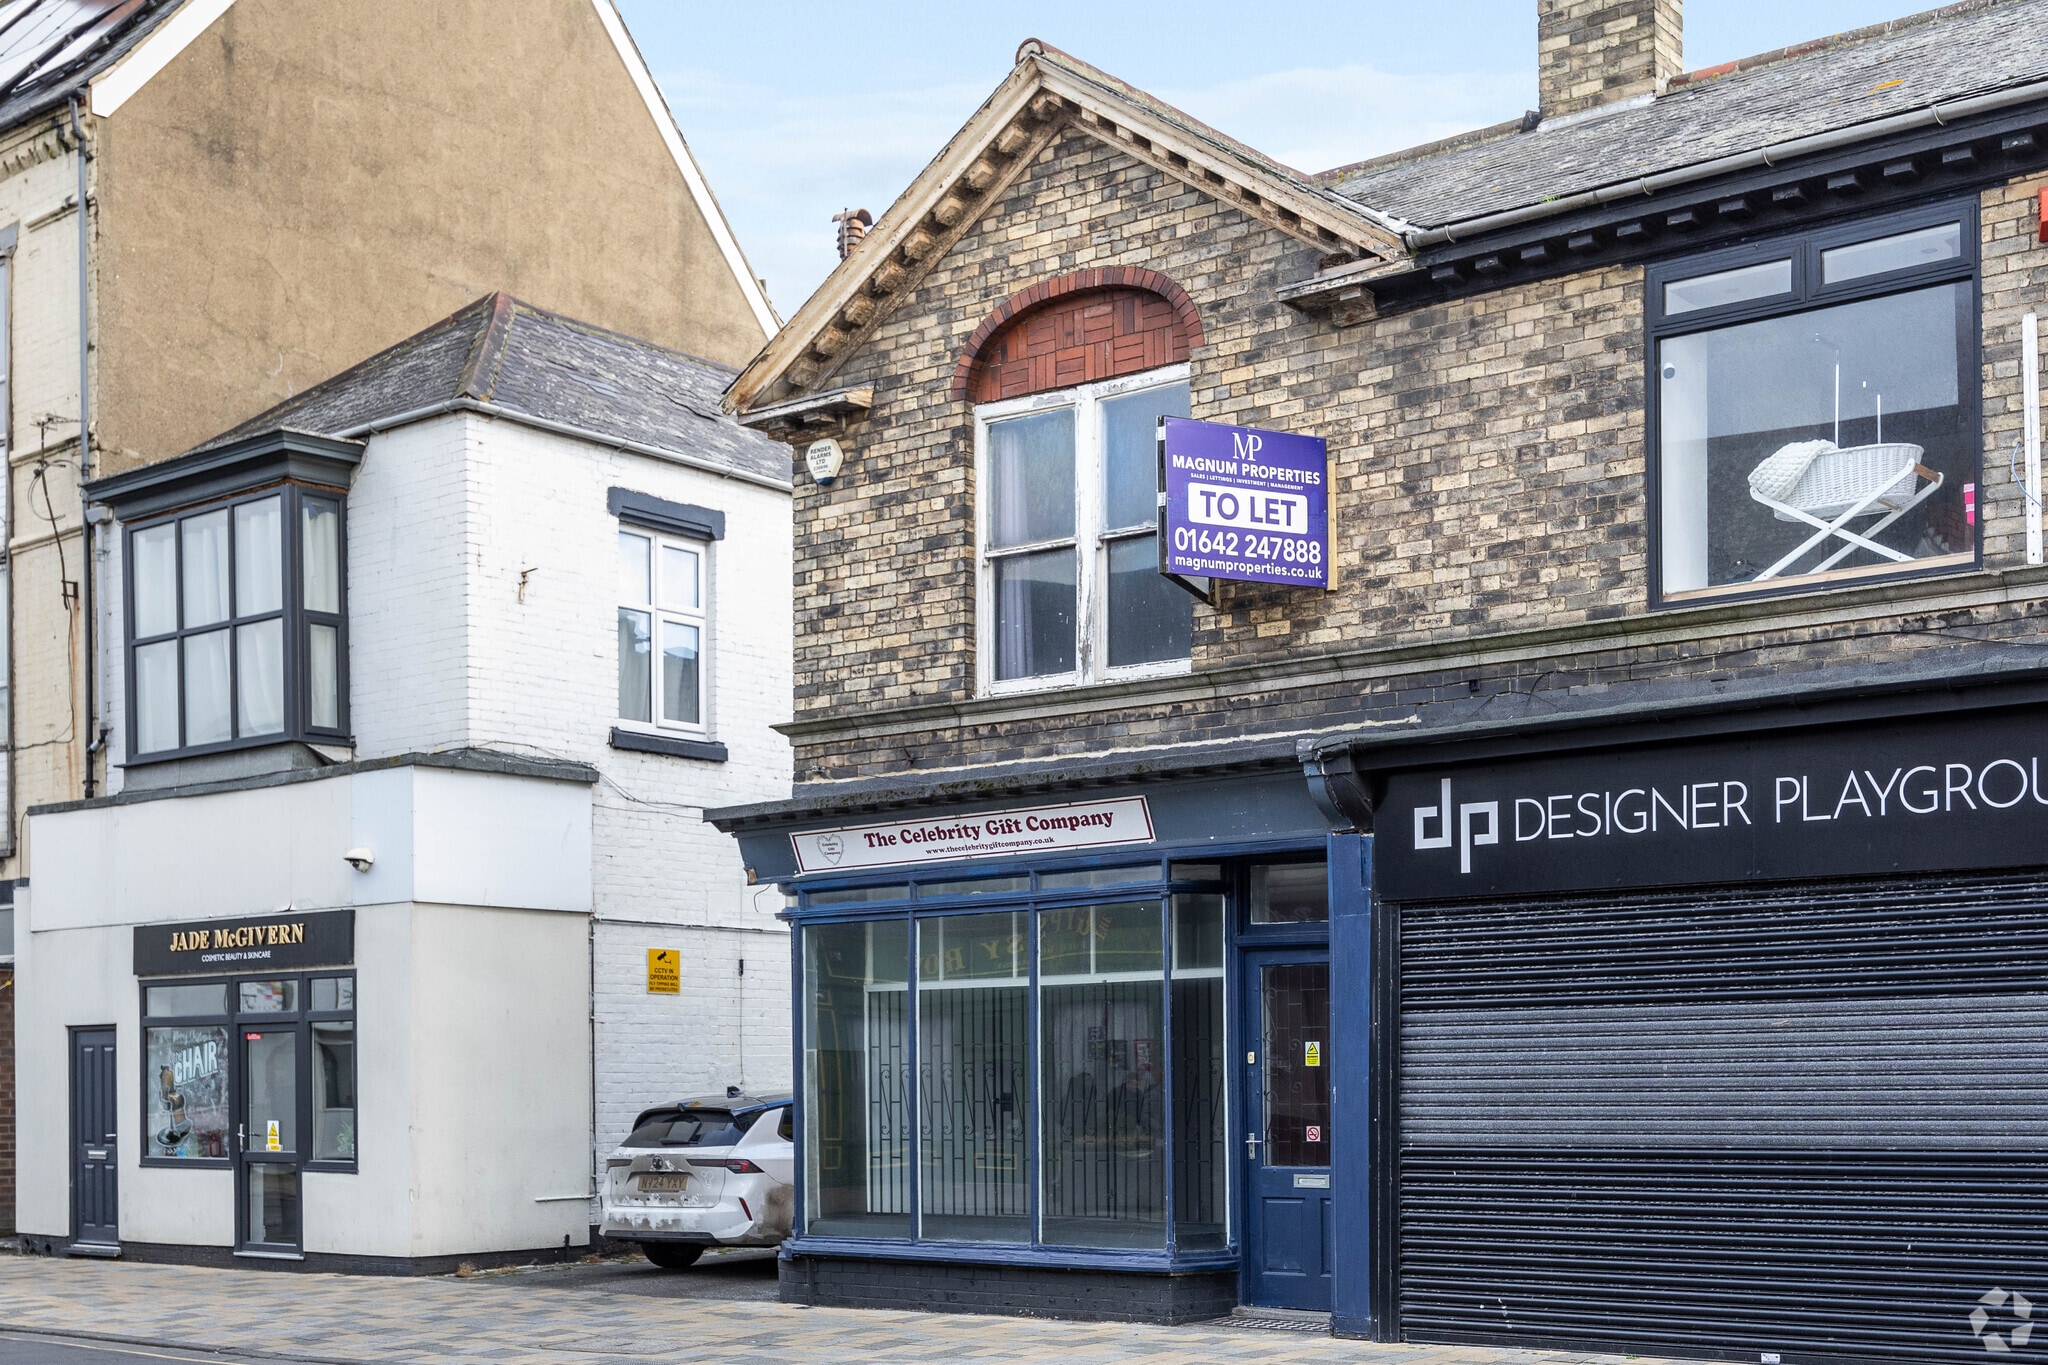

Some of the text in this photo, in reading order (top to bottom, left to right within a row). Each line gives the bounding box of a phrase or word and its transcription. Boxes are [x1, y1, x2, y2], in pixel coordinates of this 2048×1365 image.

[810, 446, 831, 454] RENDER
[810, 451, 831, 460] ALARMS
[1231, 432, 1263, 462] MP
[1172, 454, 1321, 485] MAGNUM PROPERTIES
[1190, 472, 1304, 491] SALES LETTINGS INVESTMENT MANAGEMENT
[1199, 490, 1297, 527] TO LET
[1174, 526, 1322, 564] 01642 247888
[1175, 556, 1322, 580] magnumproperties.co.uk
[1515, 780, 1752, 842] DESIGNER
[864, 811, 1114, 848] The Celebrity Gift Company
[925, 836, 1056, 855] www.thecelebritygiftcompany.co.uk
[169, 923, 305, 952] JADE McGIVERN
[201, 950, 272, 963] COSMETIC BEAUTY & SKINCARE
